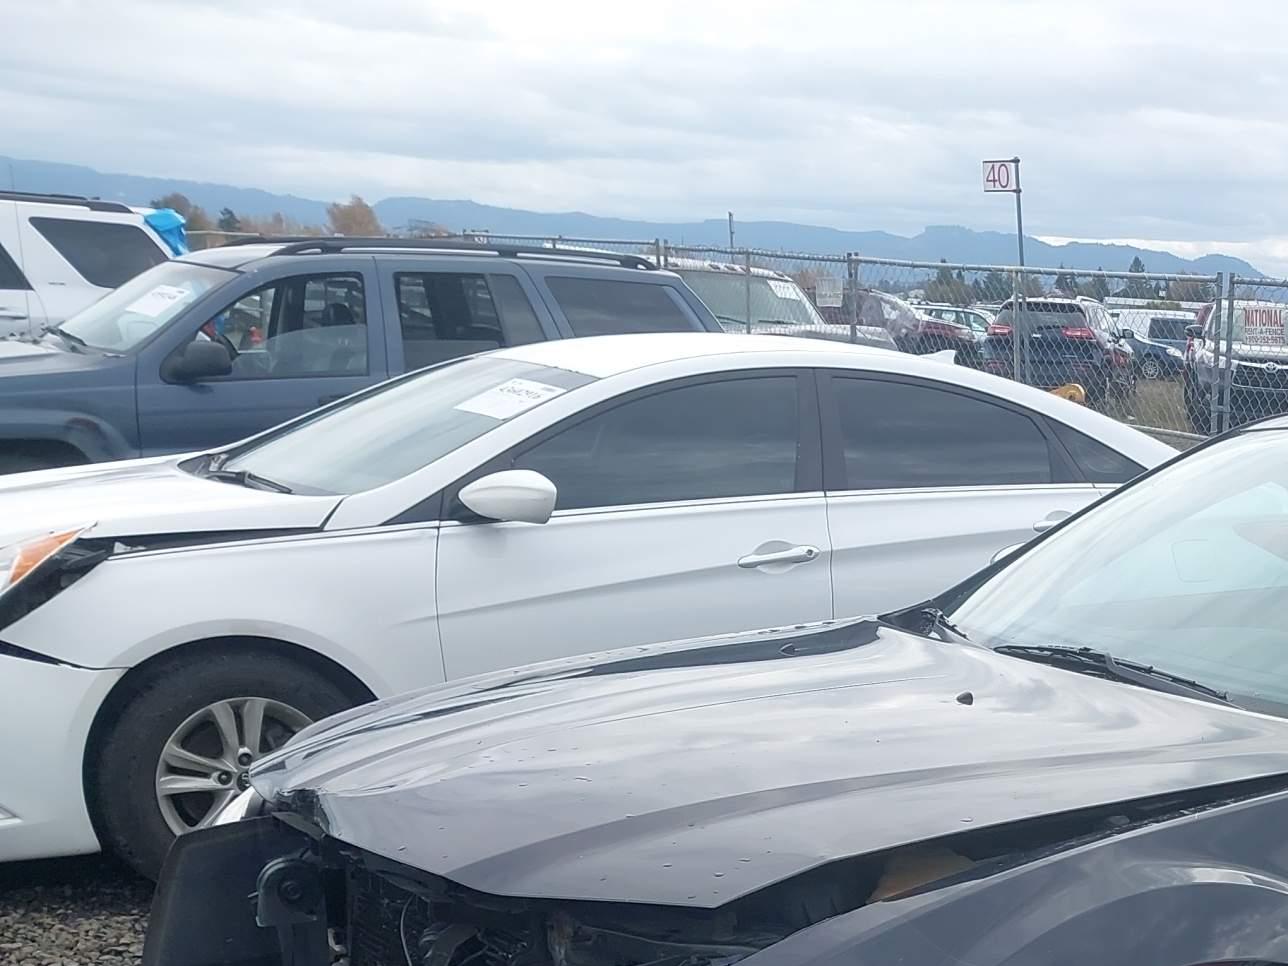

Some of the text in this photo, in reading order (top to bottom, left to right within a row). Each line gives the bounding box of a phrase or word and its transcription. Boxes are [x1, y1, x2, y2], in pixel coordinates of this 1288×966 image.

[985, 163, 1010, 189] 40
[1244, 309, 1285, 327] NATIONAL
[1244, 327, 1285, 336] RENT-A-FENCE
